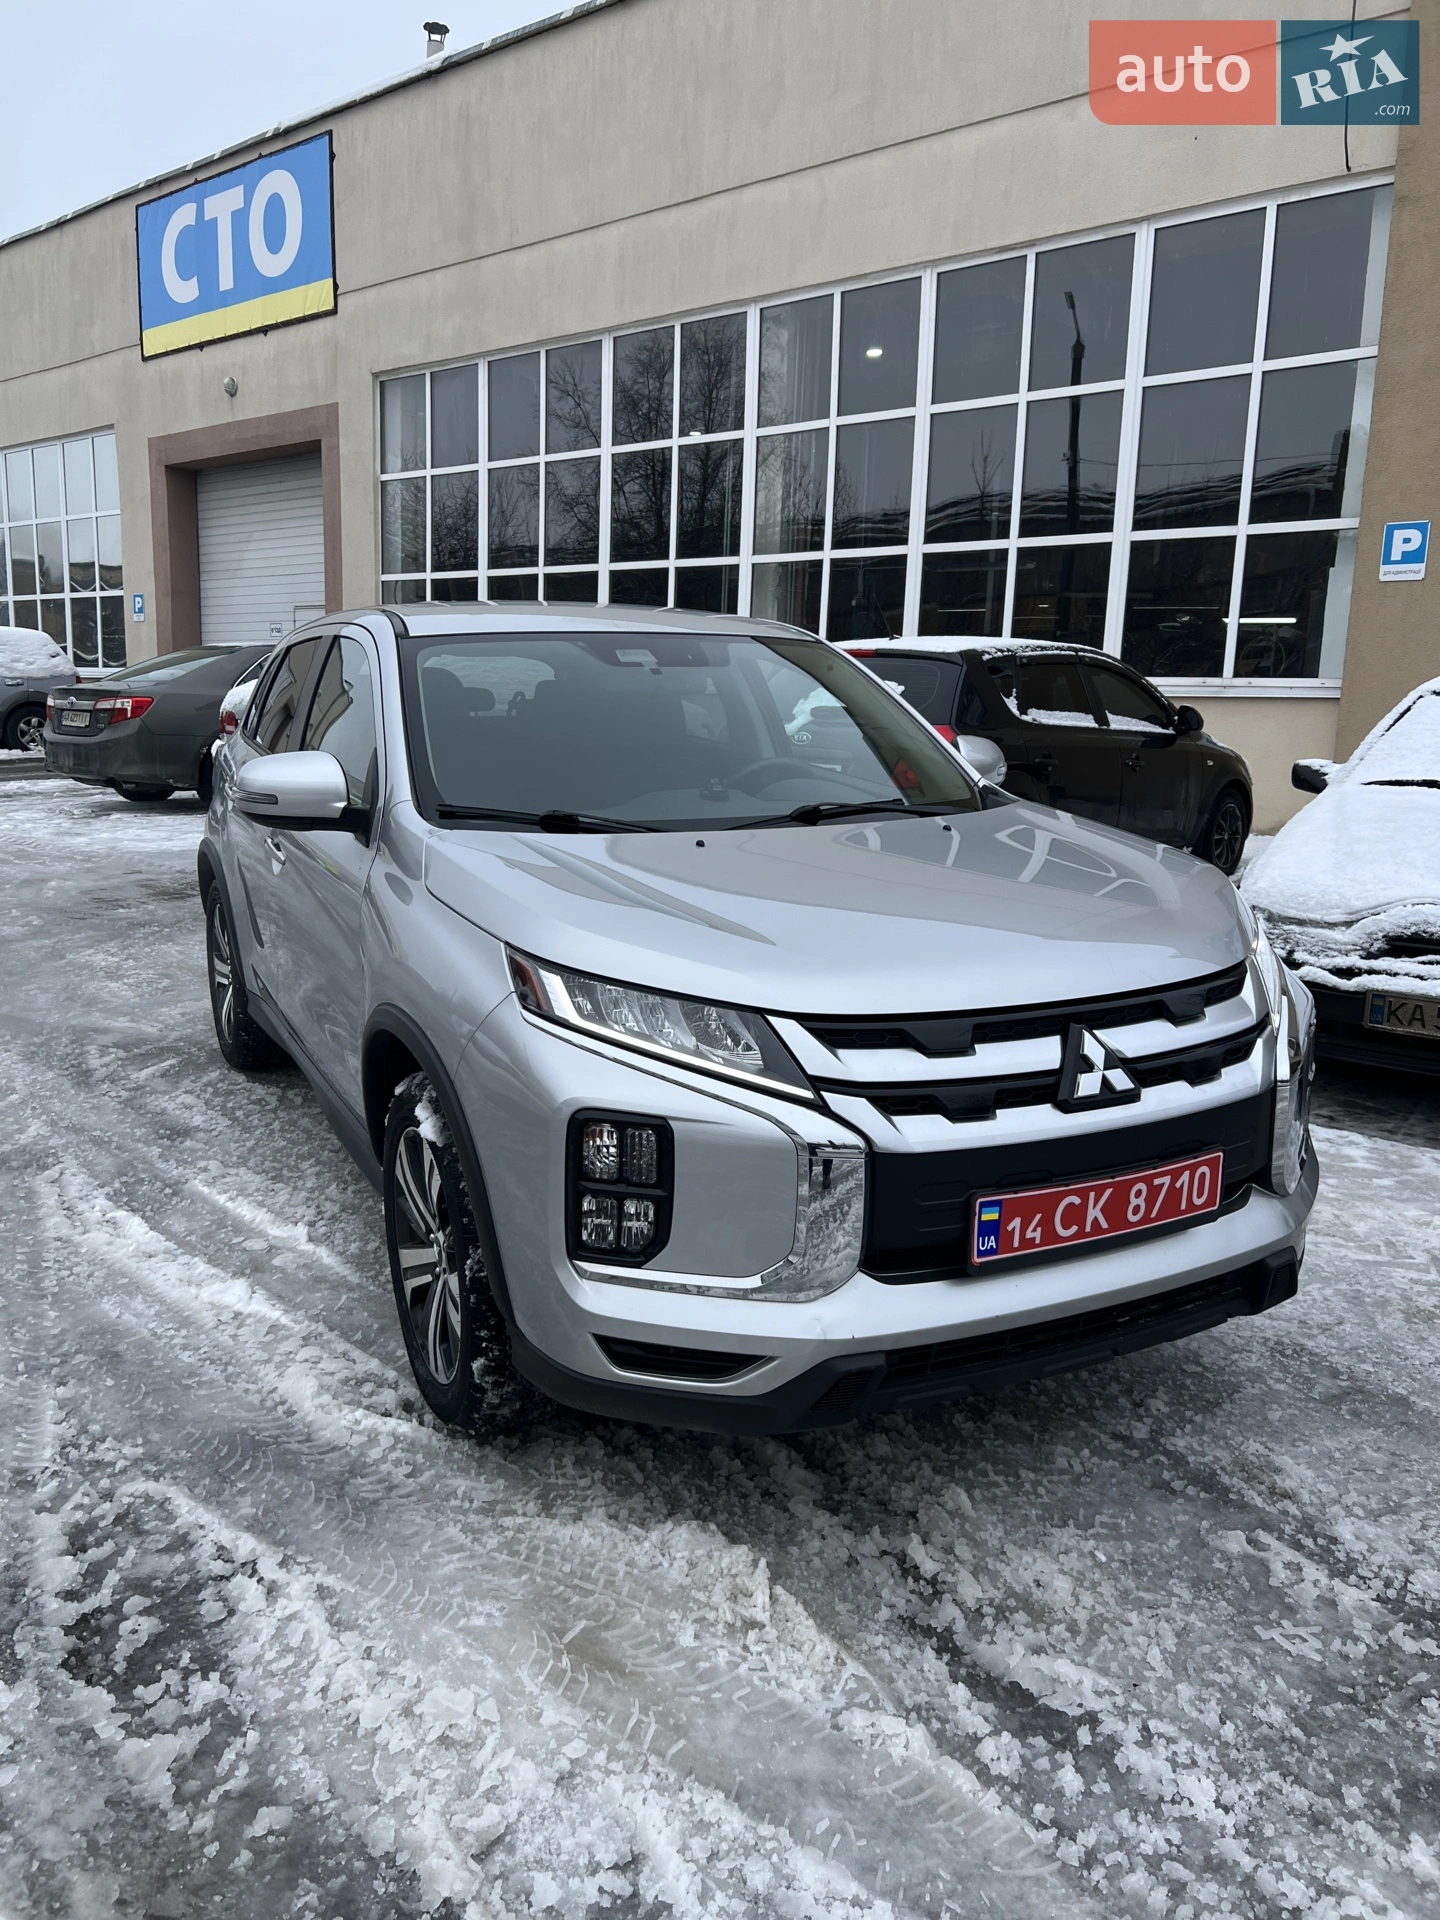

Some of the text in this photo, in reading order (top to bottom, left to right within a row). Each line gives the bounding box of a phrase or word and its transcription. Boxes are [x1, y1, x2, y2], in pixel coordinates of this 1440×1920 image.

[161, 169, 303, 304] СТО
[1390, 528, 1423, 561] P
[135, 596, 143, 612] P
[794, 734, 807, 742] KIA
[1370, 1014, 1383, 1022] UA
[1386, 998, 1427, 1029] KA
[978, 1165, 1212, 1251] UA 14 CK 8710
